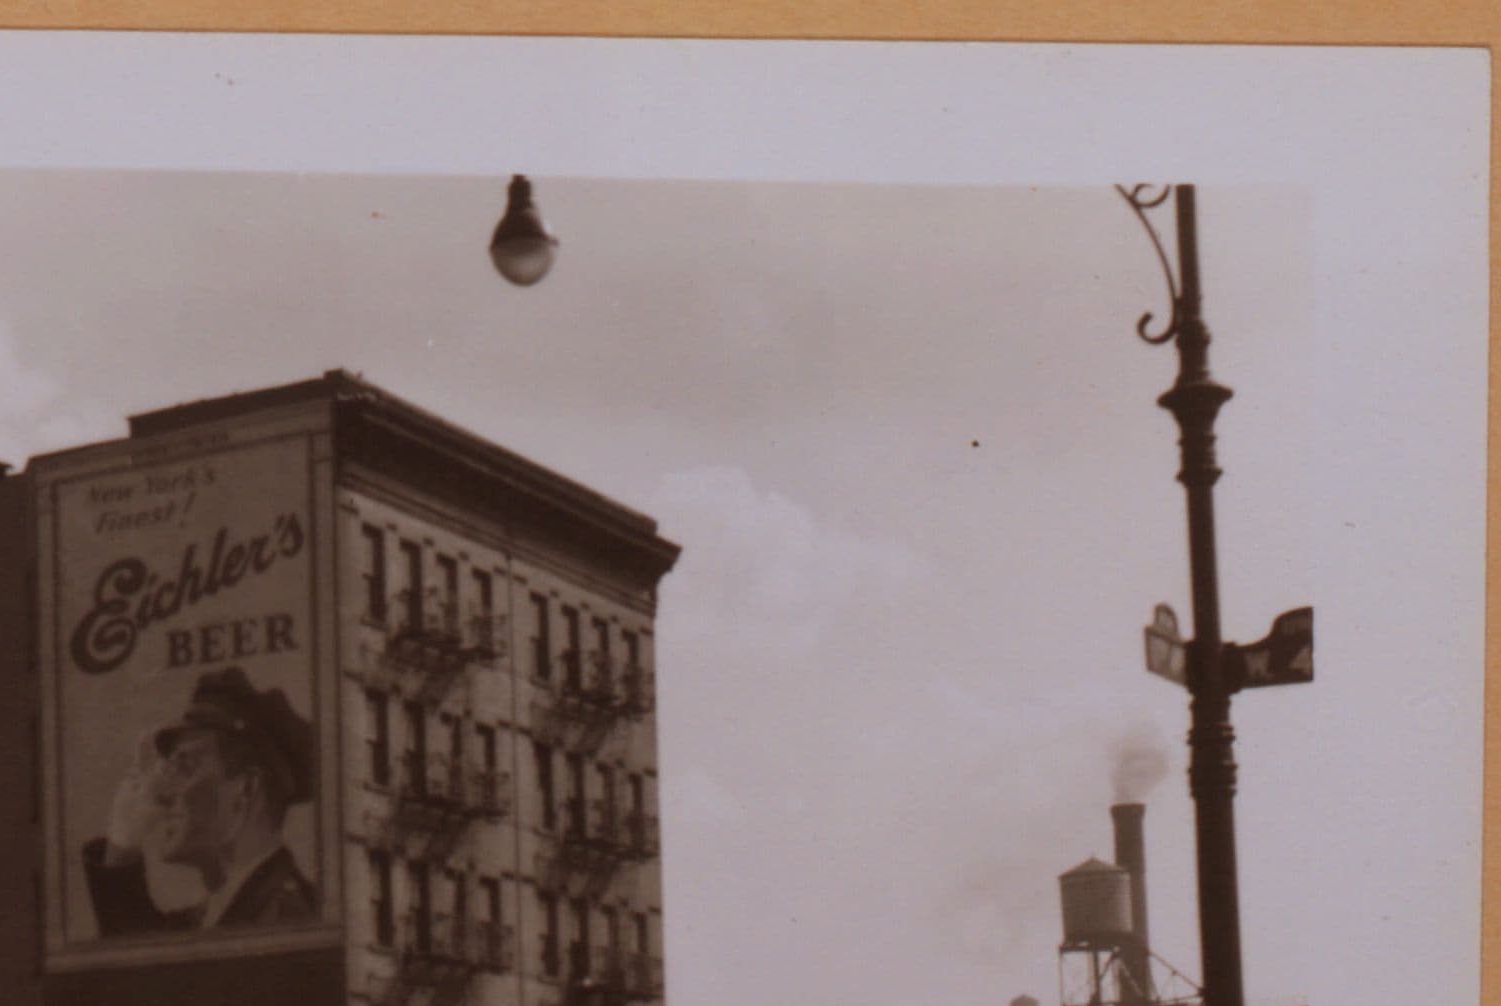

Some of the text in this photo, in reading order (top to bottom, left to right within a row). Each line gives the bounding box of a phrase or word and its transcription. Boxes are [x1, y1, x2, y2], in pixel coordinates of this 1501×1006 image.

[87, 482, 134, 504] New
[95, 490, 197, 535] Finest!
[71, 512, 304, 674] Eichler's
[165, 613, 299, 668] BEER
